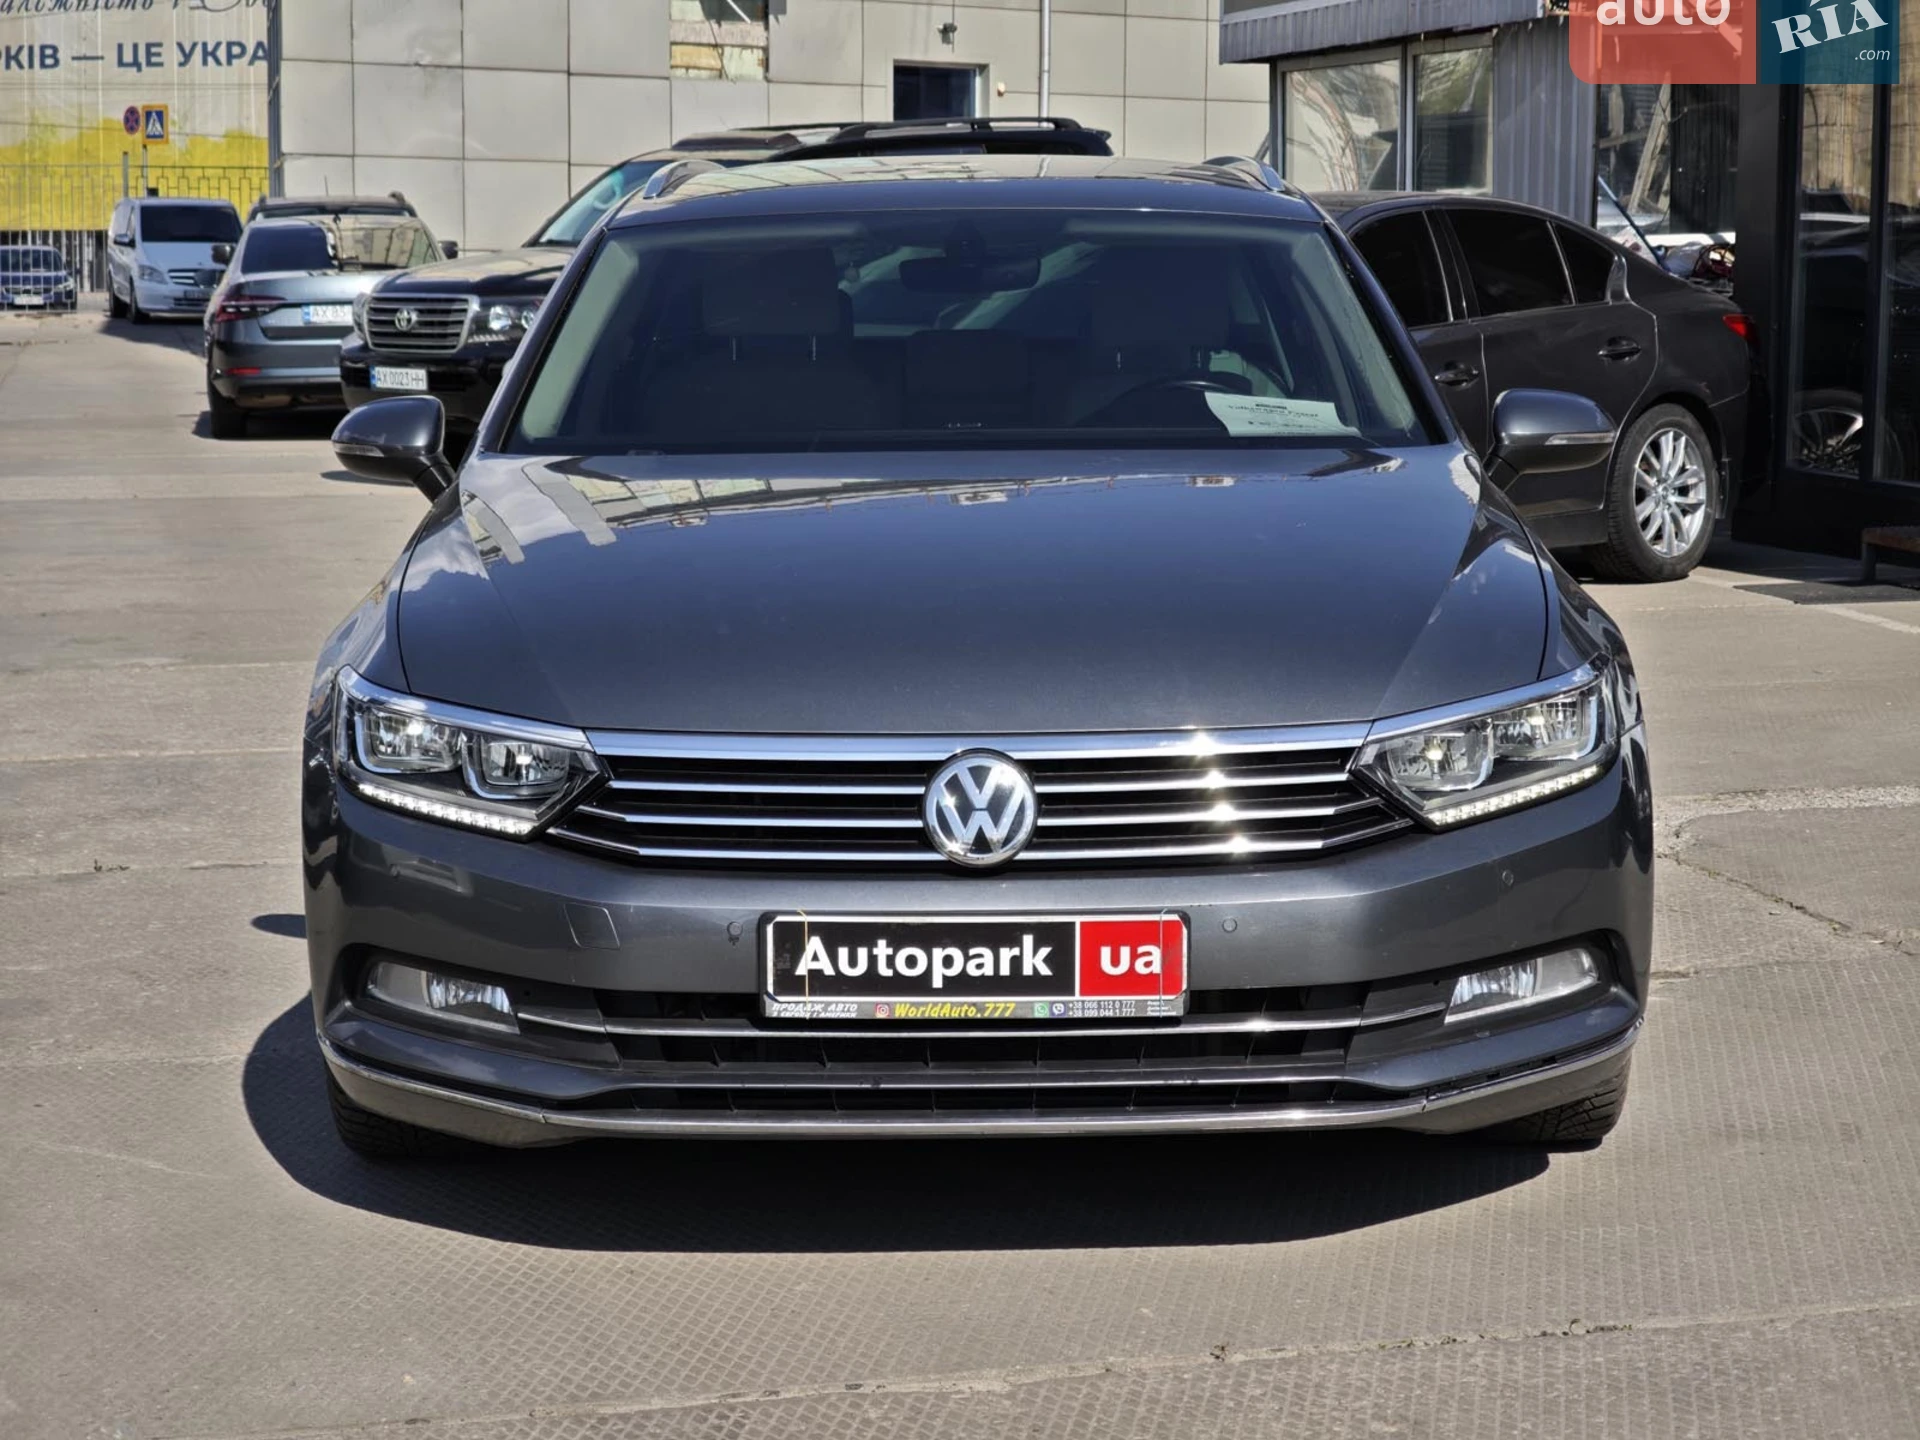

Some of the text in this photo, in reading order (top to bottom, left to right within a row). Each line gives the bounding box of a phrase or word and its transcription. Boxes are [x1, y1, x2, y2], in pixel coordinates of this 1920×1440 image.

[0, 44, 60, 71] КІВ
[117, 42, 164, 73] ЦЕ
[175, 40, 269, 68] УКРА
[794, 934, 1162, 988] Autopark ua
[827, 1002, 858, 1012] АВТО
[894, 1002, 1016, 1018] WorldAuto.777
[1068, 1001, 1082, 1009] +38
[1100, 1001, 1113, 1009] 112
[1122, 1000, 1136, 1009] 777
[1068, 1009, 1082, 1017] +38
